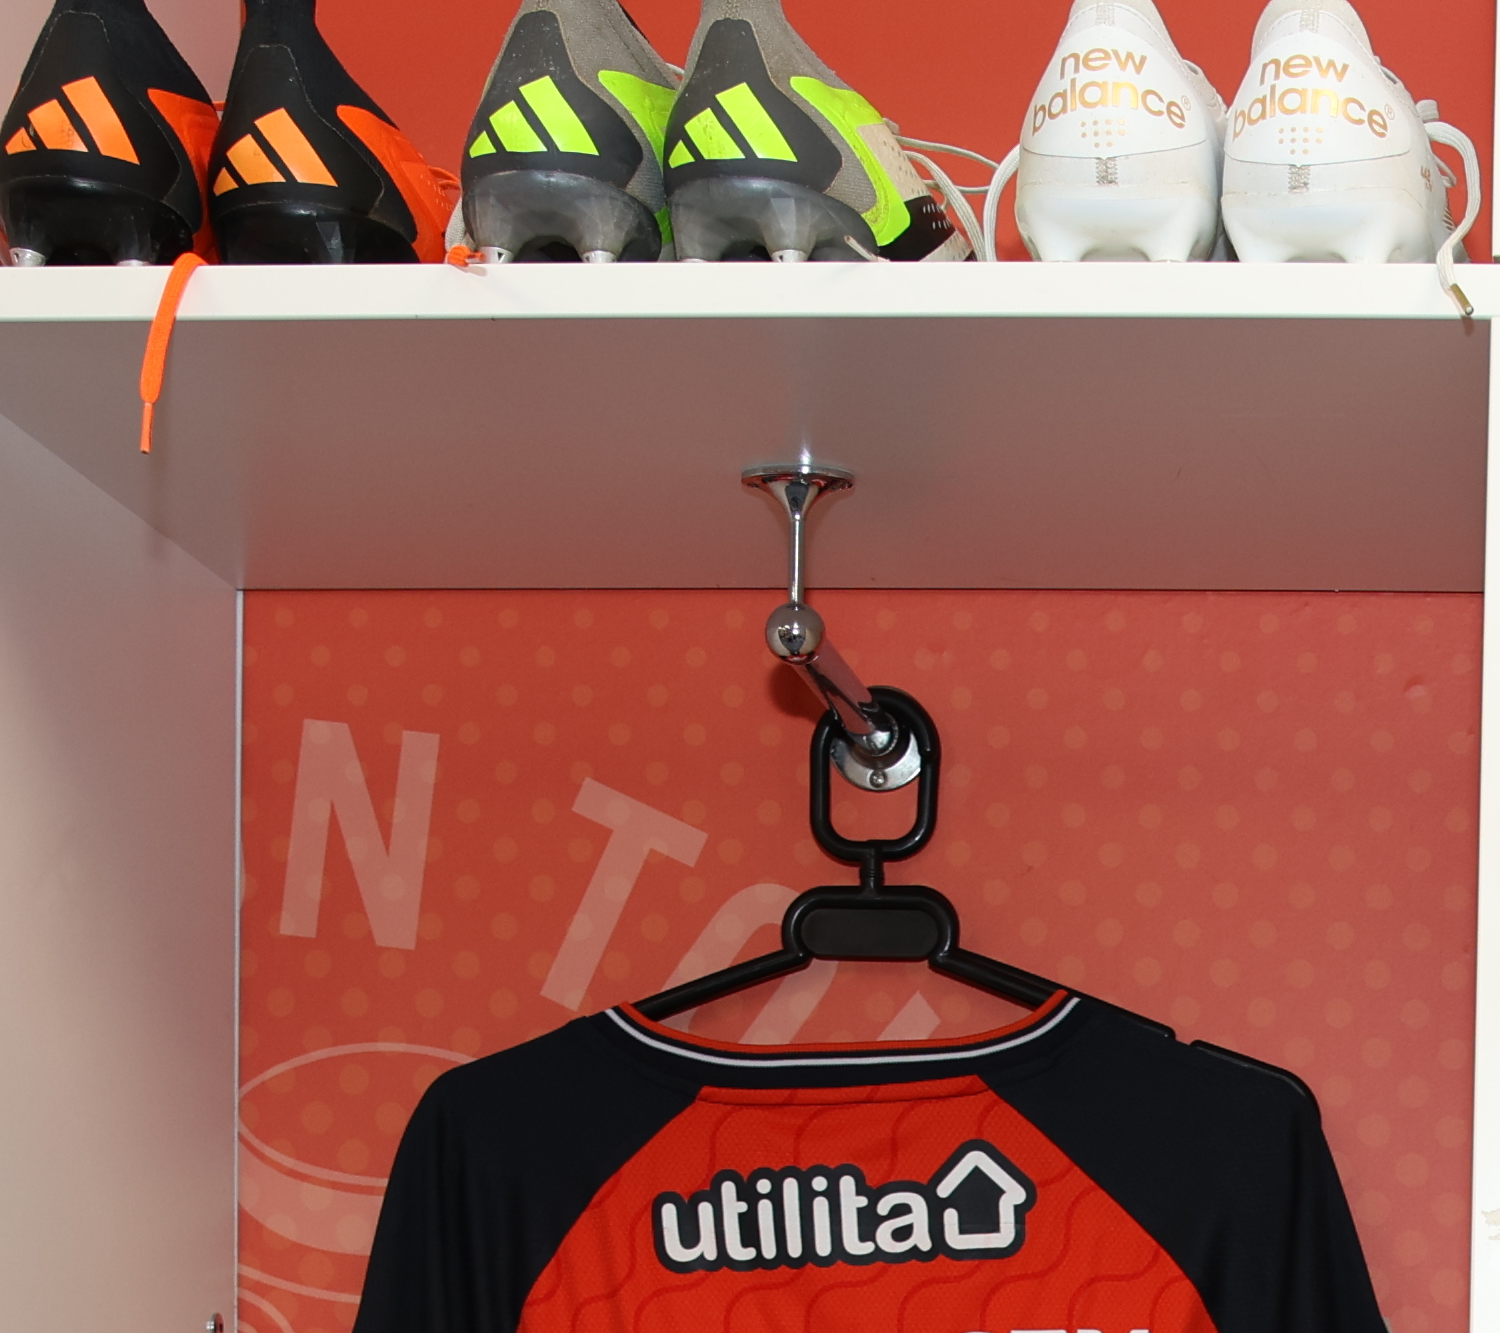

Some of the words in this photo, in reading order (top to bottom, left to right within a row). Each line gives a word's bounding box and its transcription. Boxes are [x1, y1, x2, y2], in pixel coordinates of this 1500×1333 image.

[1059, 47, 1147, 80] new
[1259, 54, 1349, 86] new
[661, 1174, 932, 1263] utilita
